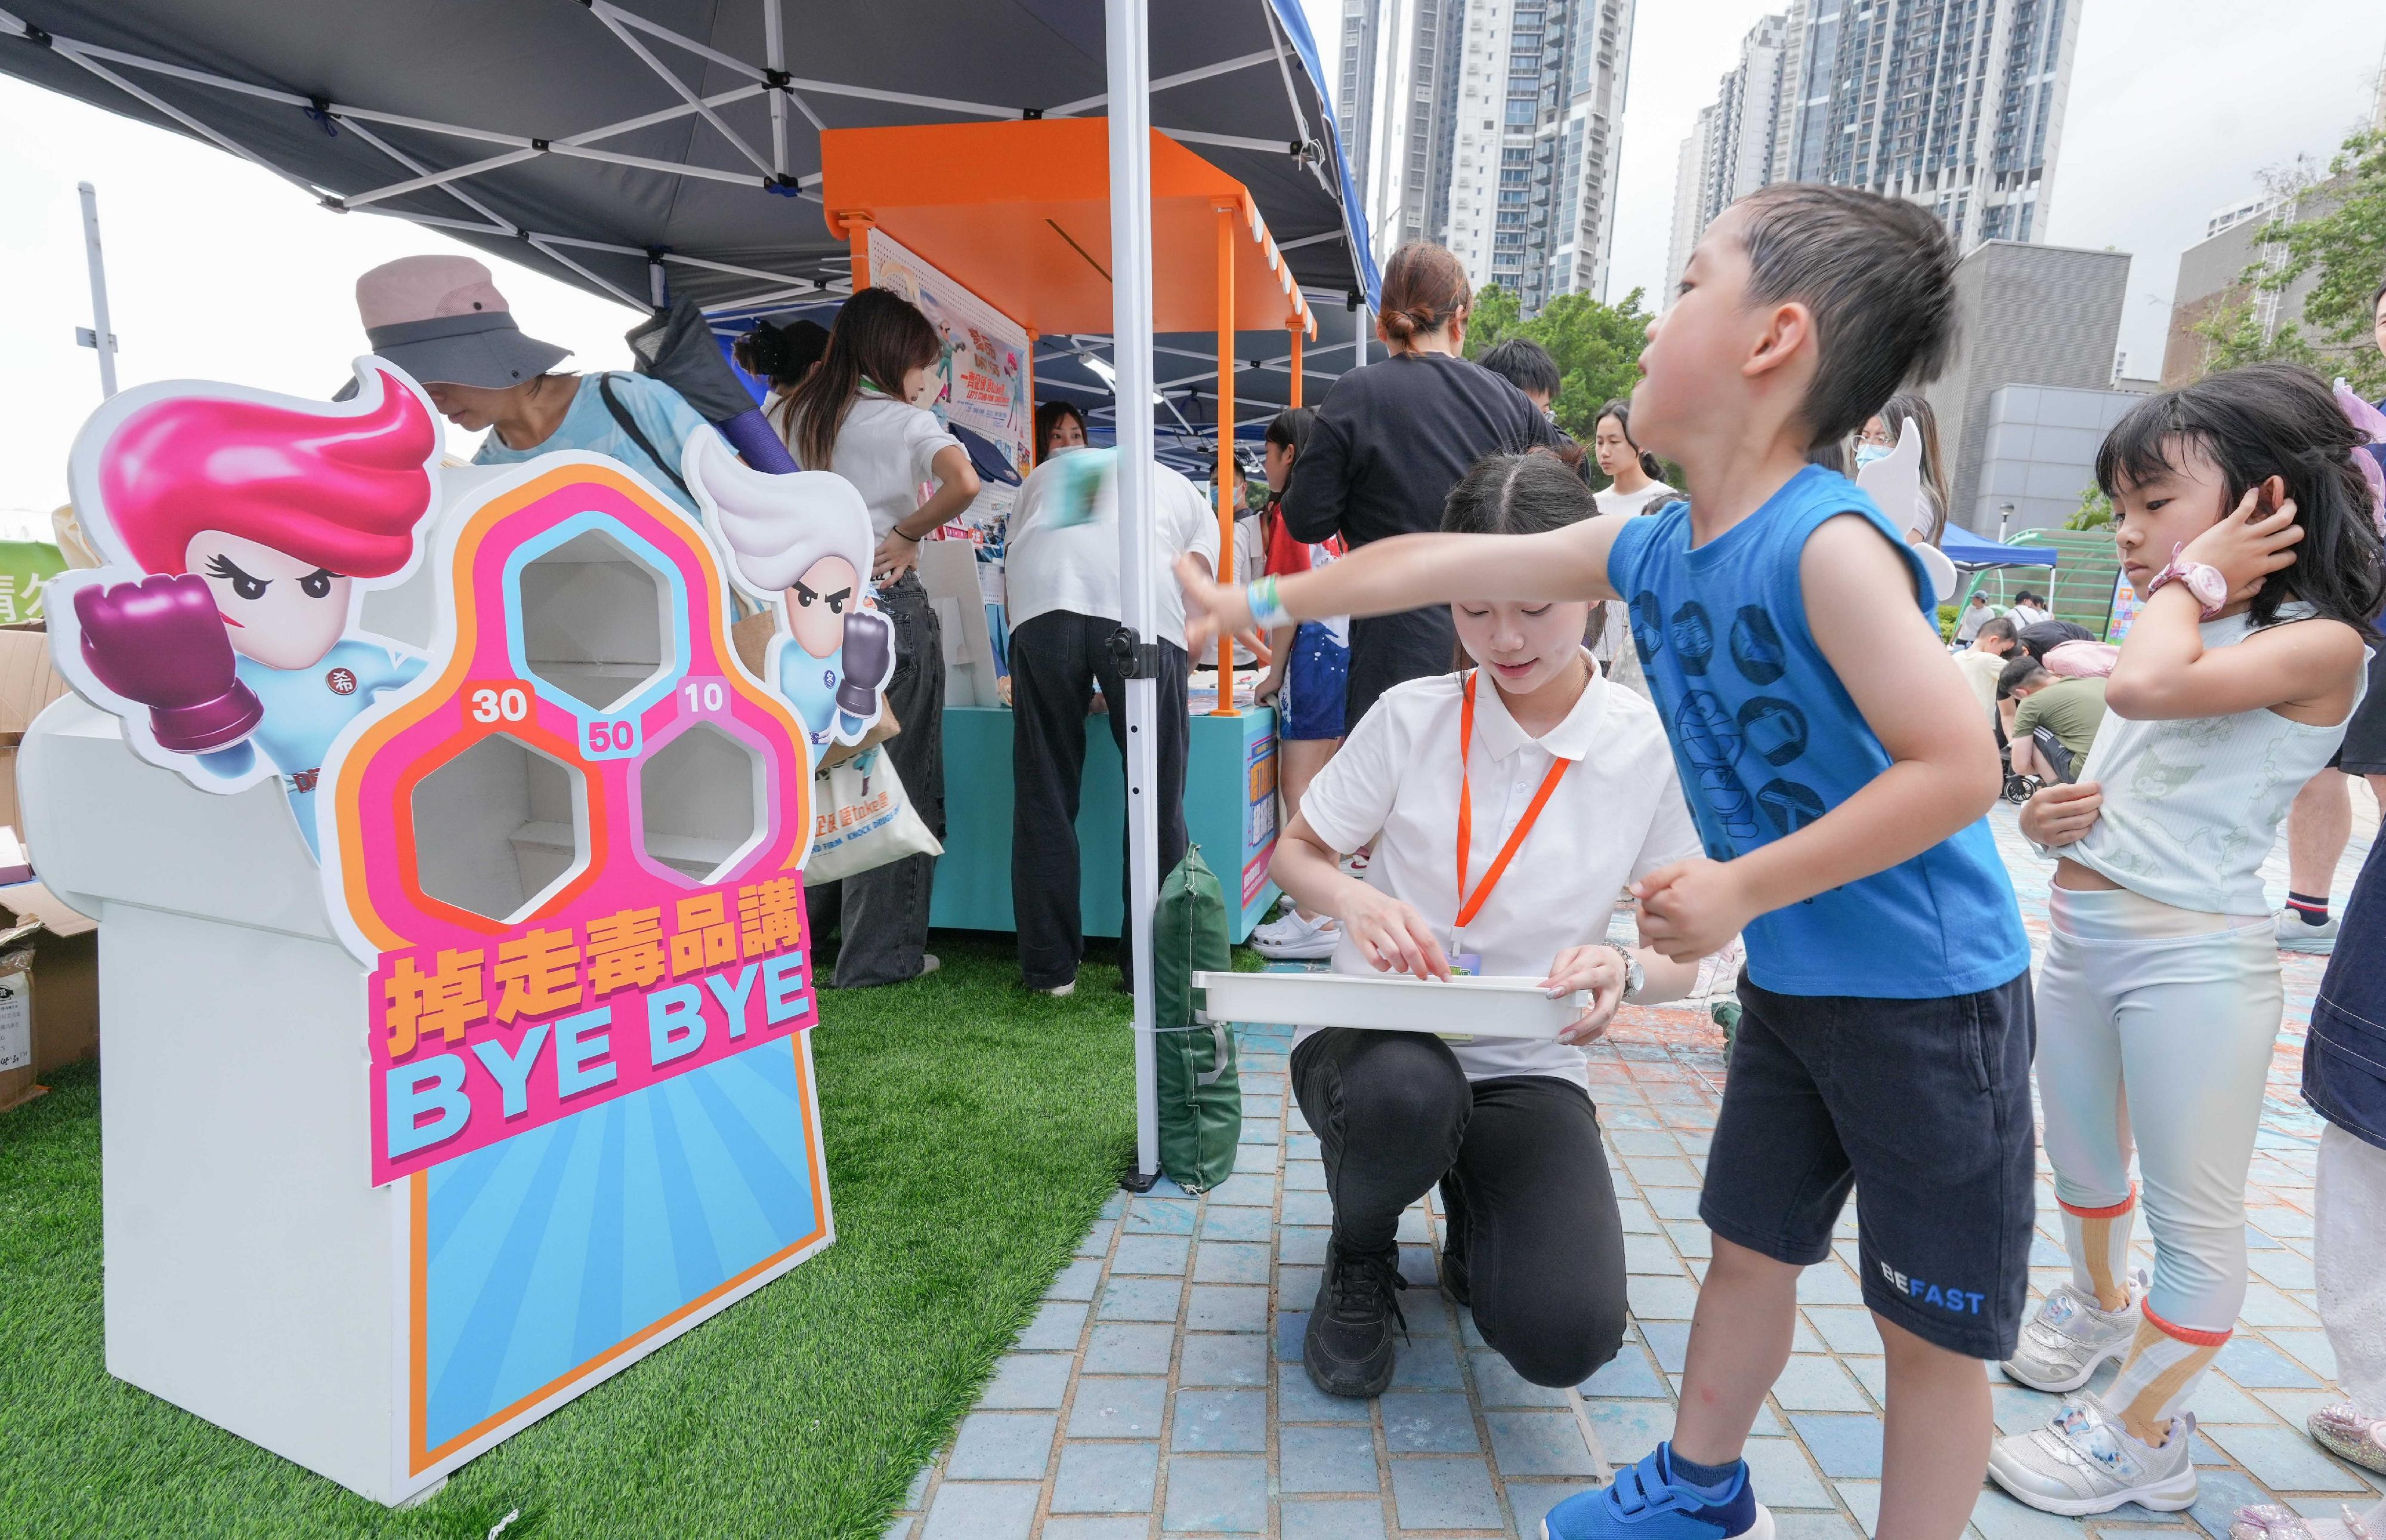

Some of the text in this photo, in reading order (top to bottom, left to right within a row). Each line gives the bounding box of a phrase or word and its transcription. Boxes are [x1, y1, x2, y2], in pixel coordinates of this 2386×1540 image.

[333, 670, 353, 692] 希
[685, 683, 723, 712] 10
[472, 688, 527, 722] 30
[588, 720, 634, 752] 50
[384, 877, 802, 1058] 掉走毒品講
[387, 950, 810, 1160] BYE BYE
